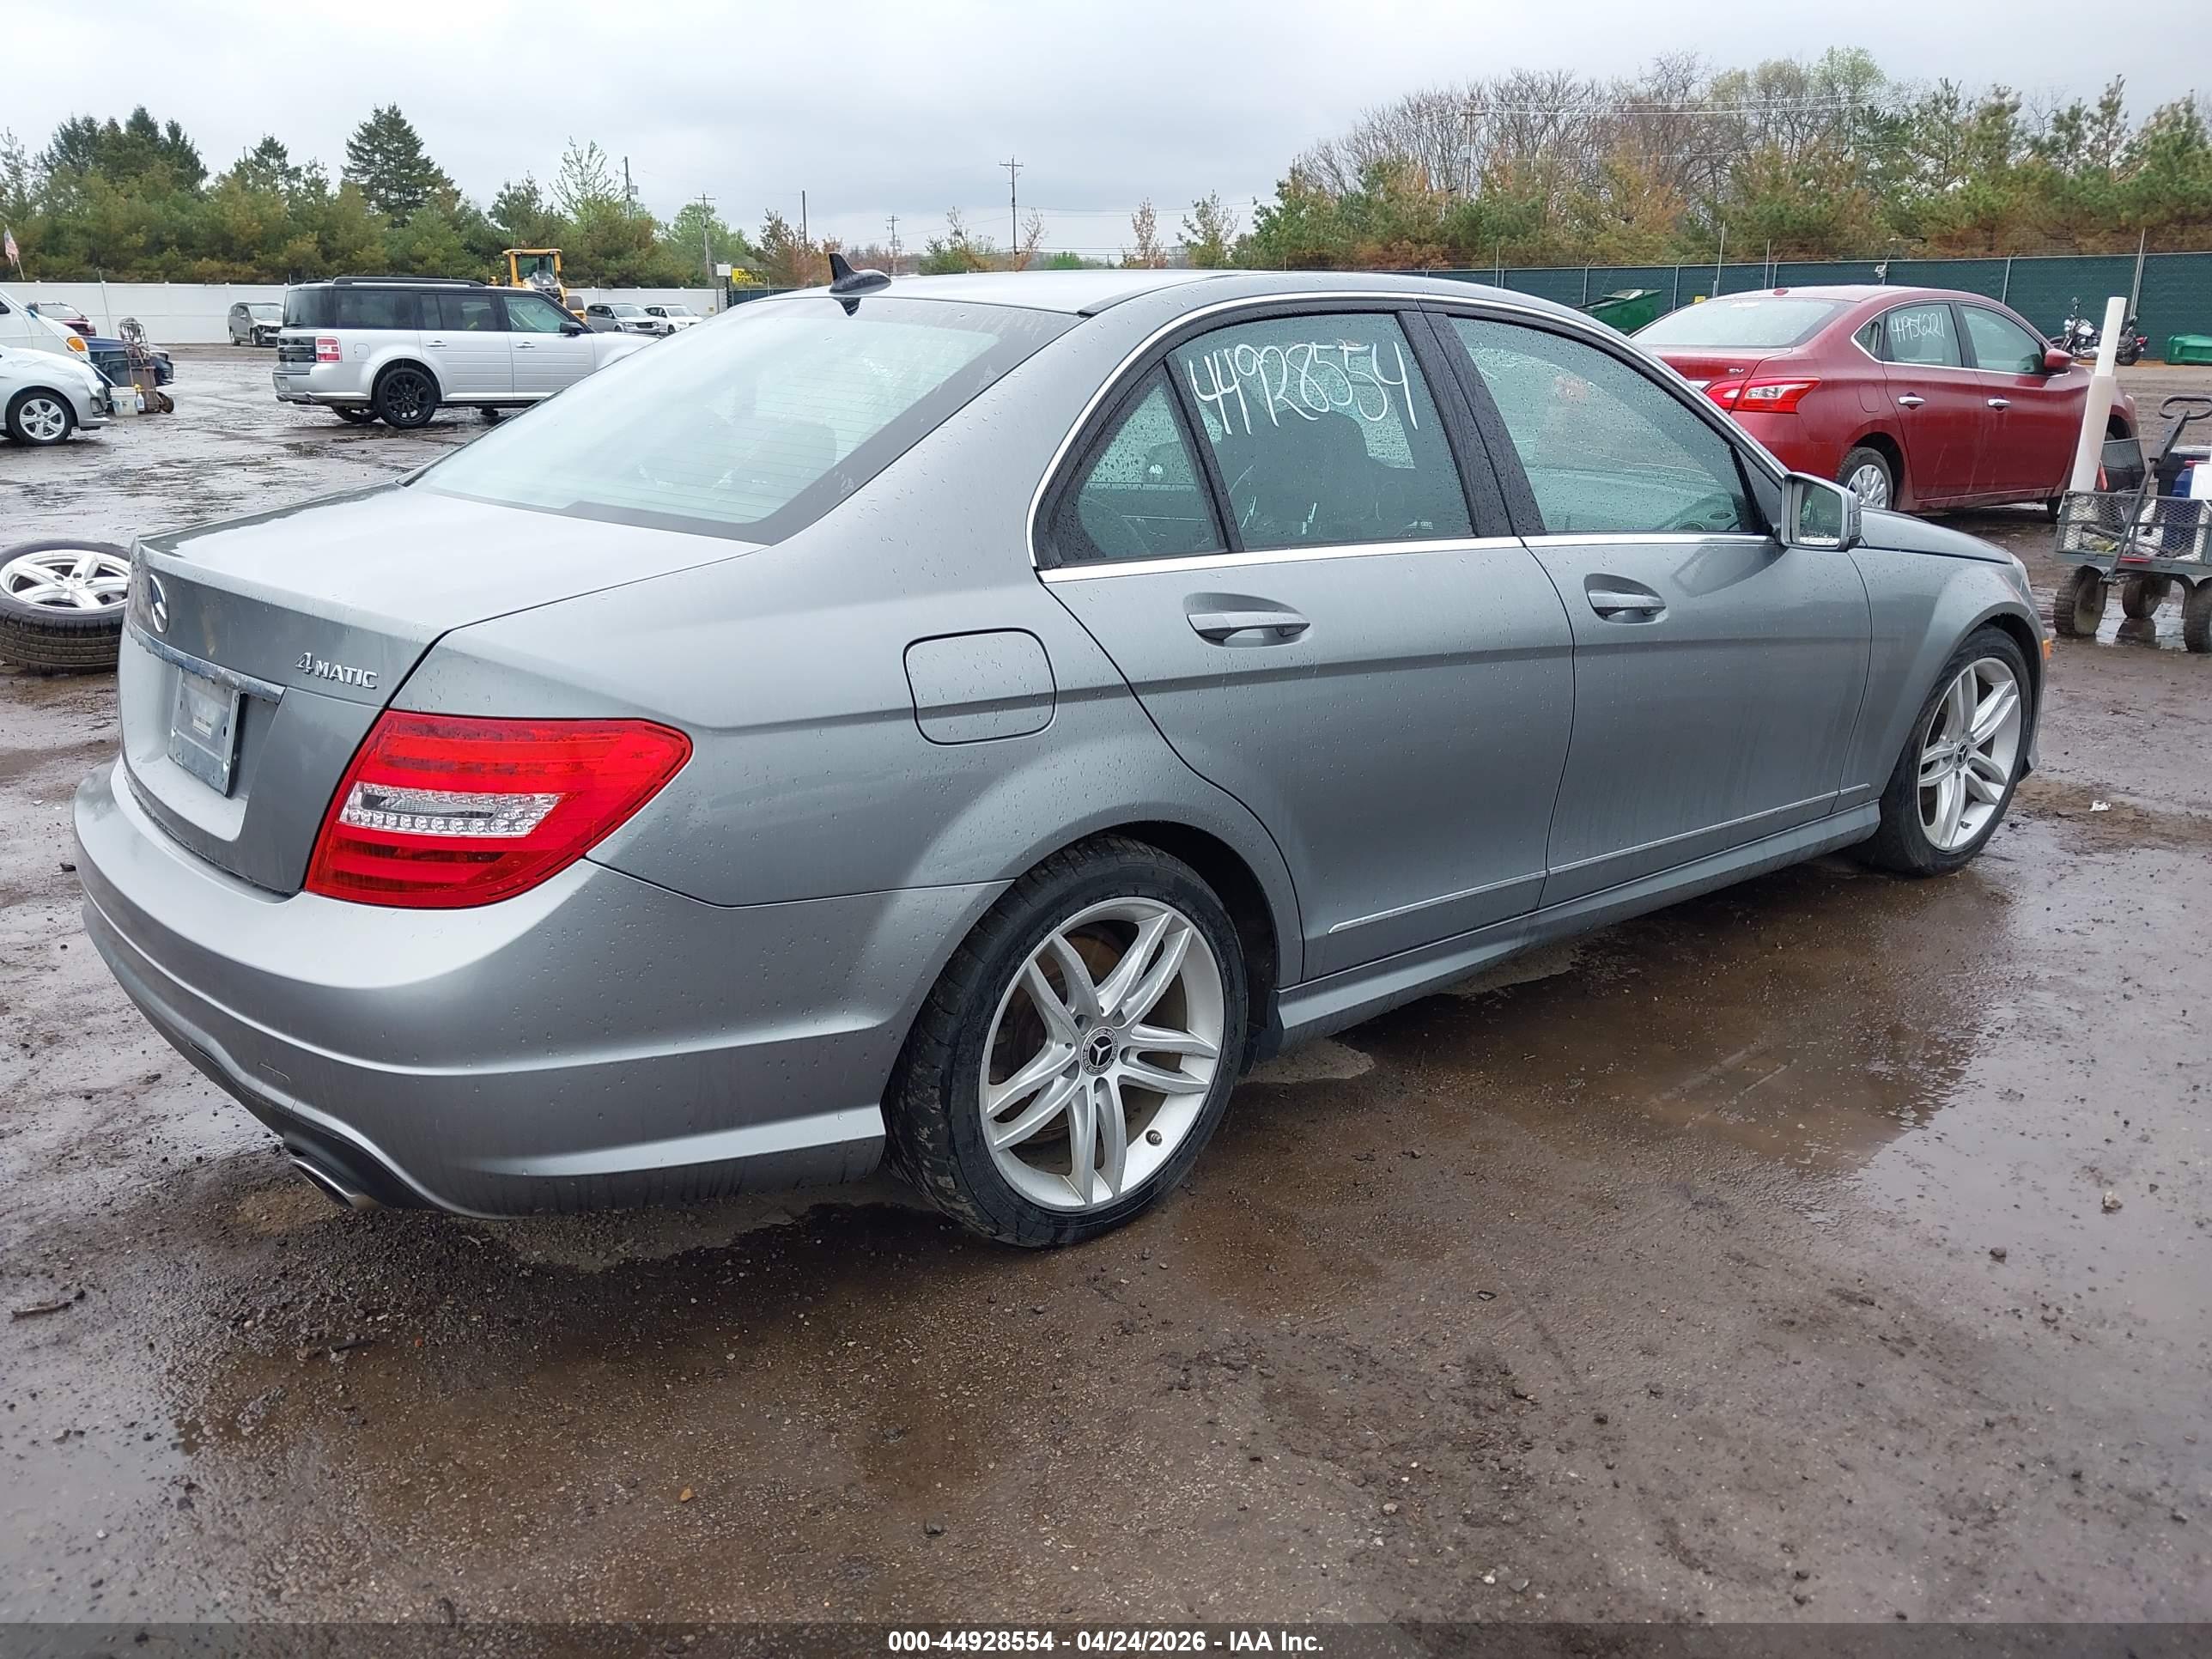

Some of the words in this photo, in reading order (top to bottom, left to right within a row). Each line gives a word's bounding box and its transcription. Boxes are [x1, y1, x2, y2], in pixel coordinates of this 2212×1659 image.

[1891, 312, 1945, 343] 44956221
[1188, 339, 1418, 435] 44928554
[295, 652, 379, 690] 4MATIC
